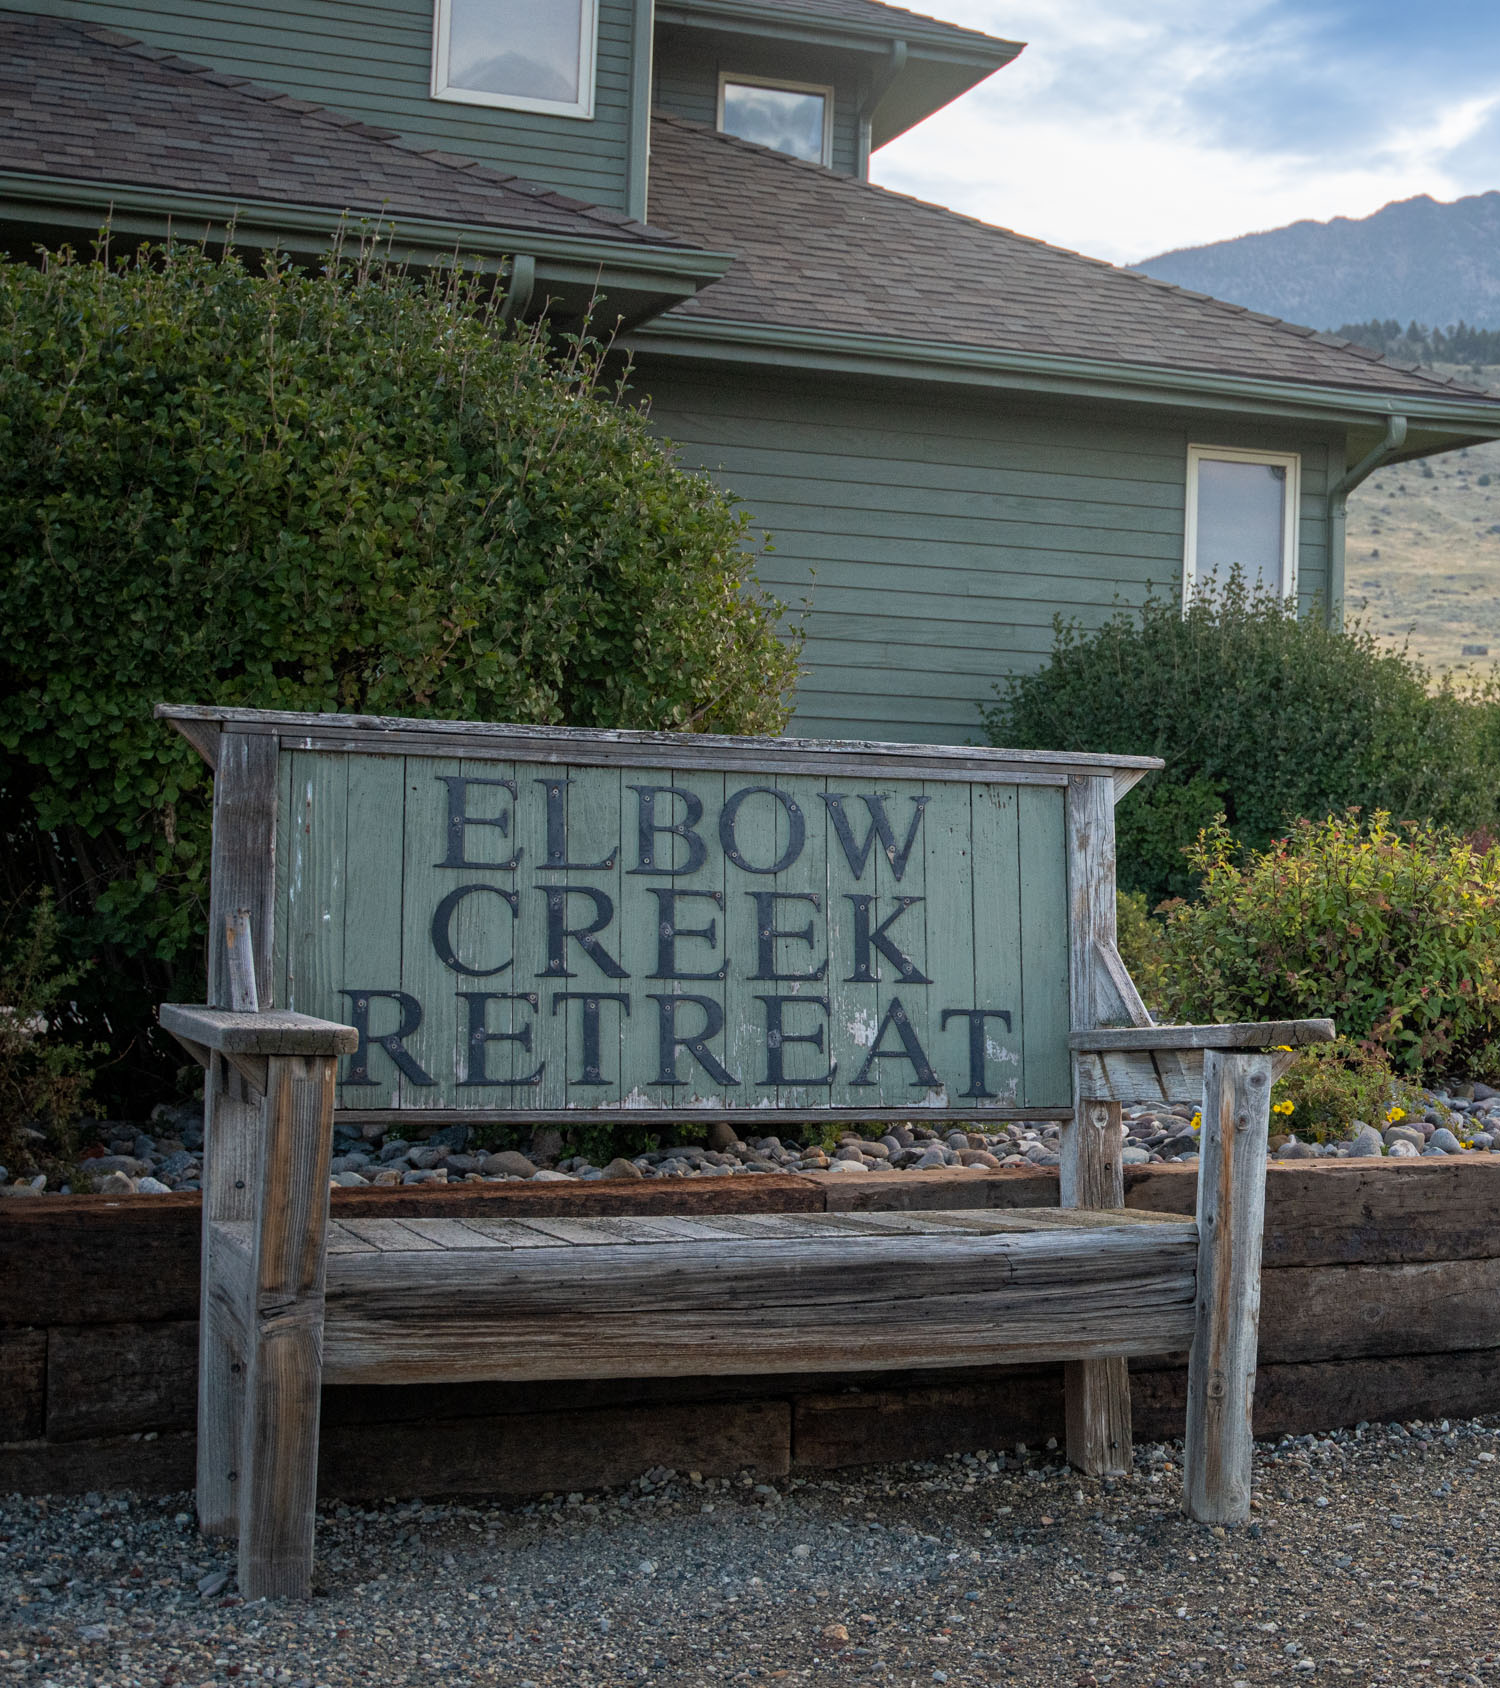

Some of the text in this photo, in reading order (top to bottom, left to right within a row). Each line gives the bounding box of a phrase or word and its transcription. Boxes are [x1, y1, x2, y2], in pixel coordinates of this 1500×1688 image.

[434, 776, 931, 880] ELBOW
[431, 884, 934, 984] CREEK
[339, 990, 1011, 1098] RETREAT
